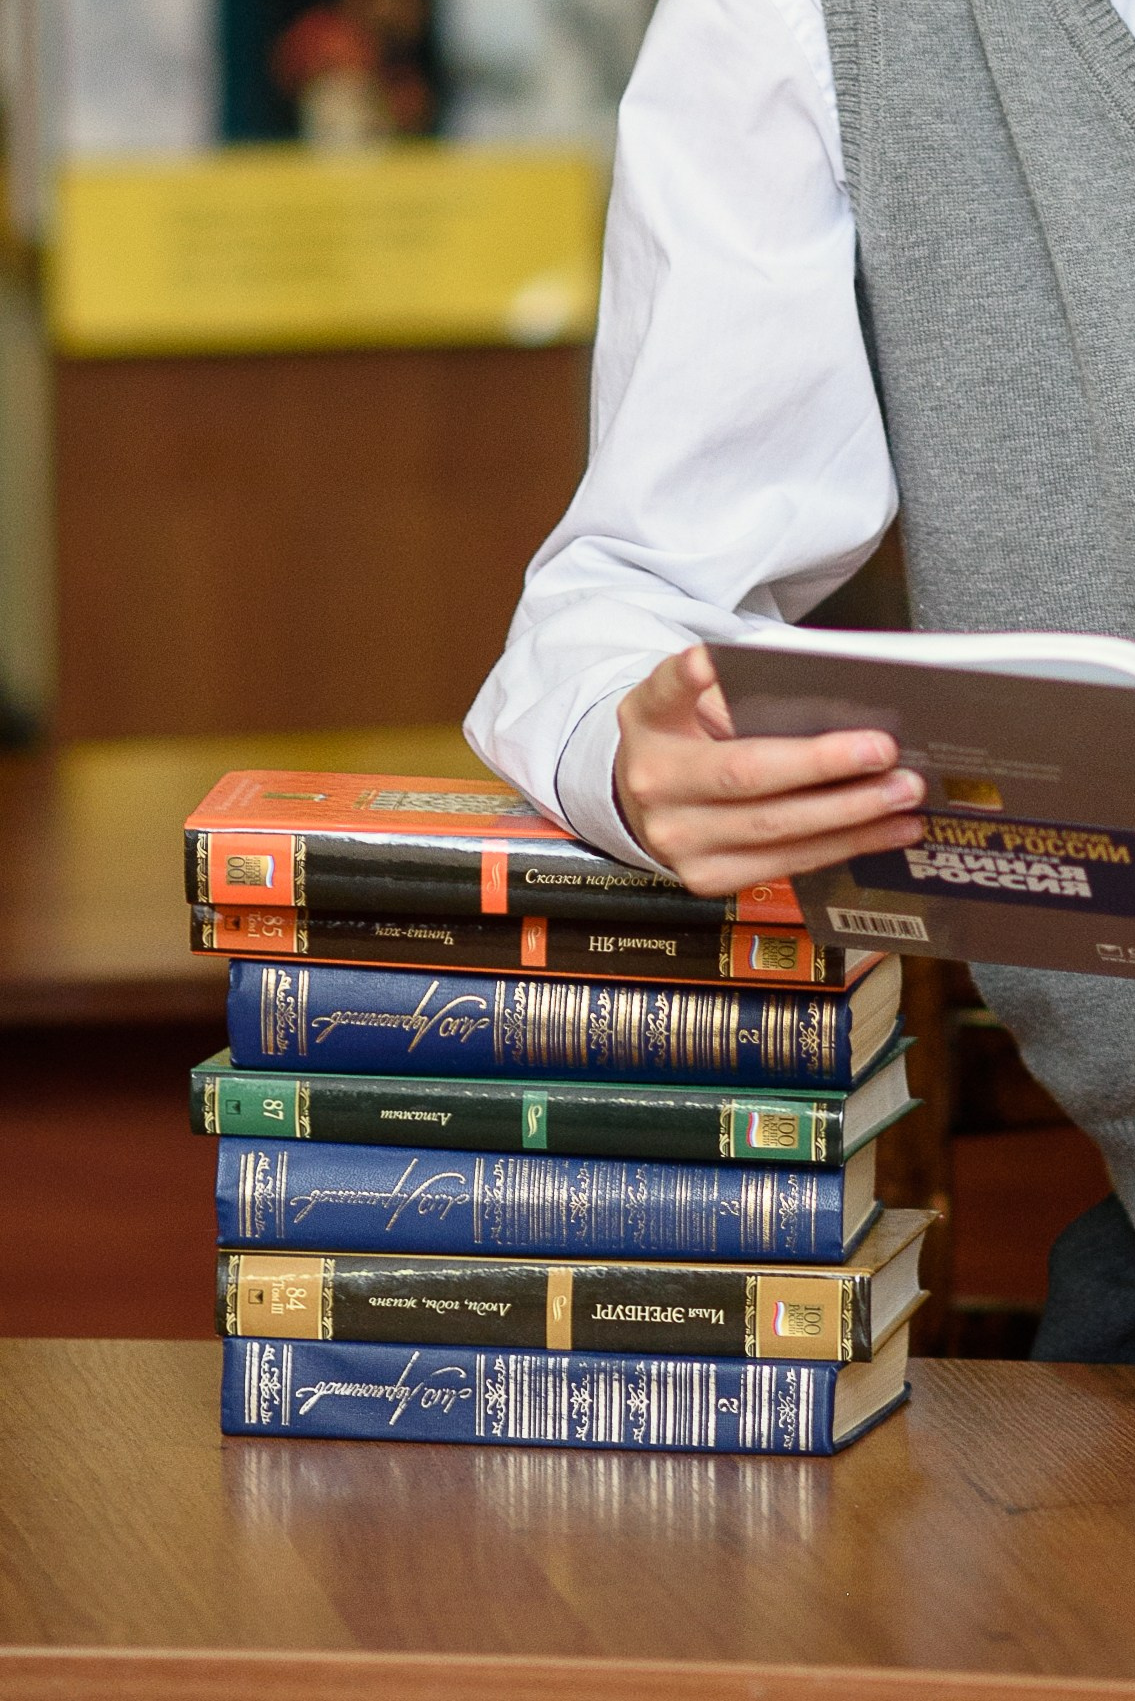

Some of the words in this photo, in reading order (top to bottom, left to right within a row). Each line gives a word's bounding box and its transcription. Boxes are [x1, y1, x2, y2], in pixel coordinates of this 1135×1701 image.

[1002, 831, 1130, 864] РОССИИ
[227, 856, 246, 885] 100
[904, 849, 1088, 882] ЕДИНАЯ
[525, 868, 582, 886] Сказки
[586, 871, 648, 890] народов
[908, 864, 1093, 898] РОССИЯ
[262, 915, 283, 937] 85
[588, 935, 614, 953] ЯН
[618, 936, 678, 957] Василий
[778, 940, 796, 969] 100
[263, 1099, 284, 1121] 87
[380, 1109, 452, 1126] Алпамыш
[778, 1116, 795, 1146] 100
[286, 1287, 307, 1310] 84
[369, 1297, 418, 1309] жизнь
[464, 1299, 511, 1317] Люди,
[591, 1303, 685, 1324] ЭРЕНБУРГ
[688, 1308, 725, 1325] Илья
[804, 1305, 821, 1336] 100
